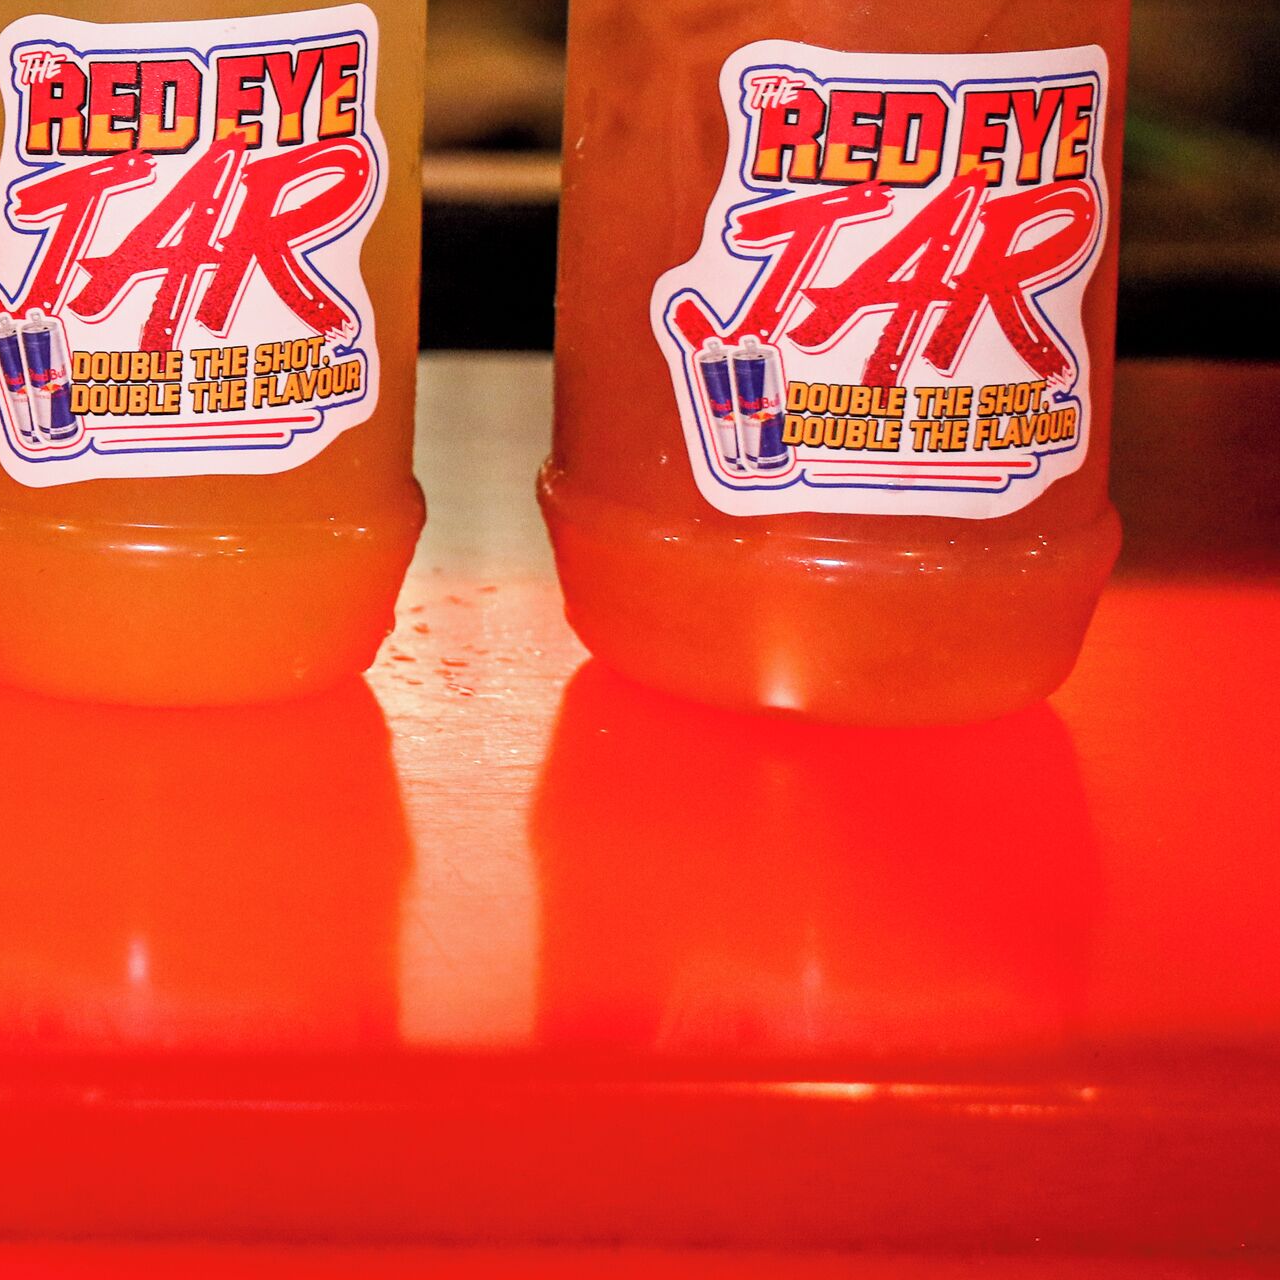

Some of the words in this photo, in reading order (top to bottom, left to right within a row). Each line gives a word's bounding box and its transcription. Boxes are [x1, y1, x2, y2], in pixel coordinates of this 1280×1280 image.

[19, 50, 65, 86] THE
[25, 59, 203, 156] RED
[215, 42, 361, 151] EYE
[750, 76, 804, 109] THE
[751, 87, 949, 187] RED
[955, 83, 1095, 187] EYE
[674, 168, 1099, 385] JAR
[69, 382, 179, 416] DOUBLE
[190, 380, 246, 415] THE
[253, 359, 361, 409] FLAVOUR
[71, 350, 182, 385] DOUBLE
[190, 346, 253, 382] THE
[785, 379, 905, 419] DOUBLE
[912, 383, 975, 419] THE
[781, 415, 900, 452] DOUBLE
[909, 418, 971, 453] THE
[973, 407, 1076, 451] FLAVOUR
